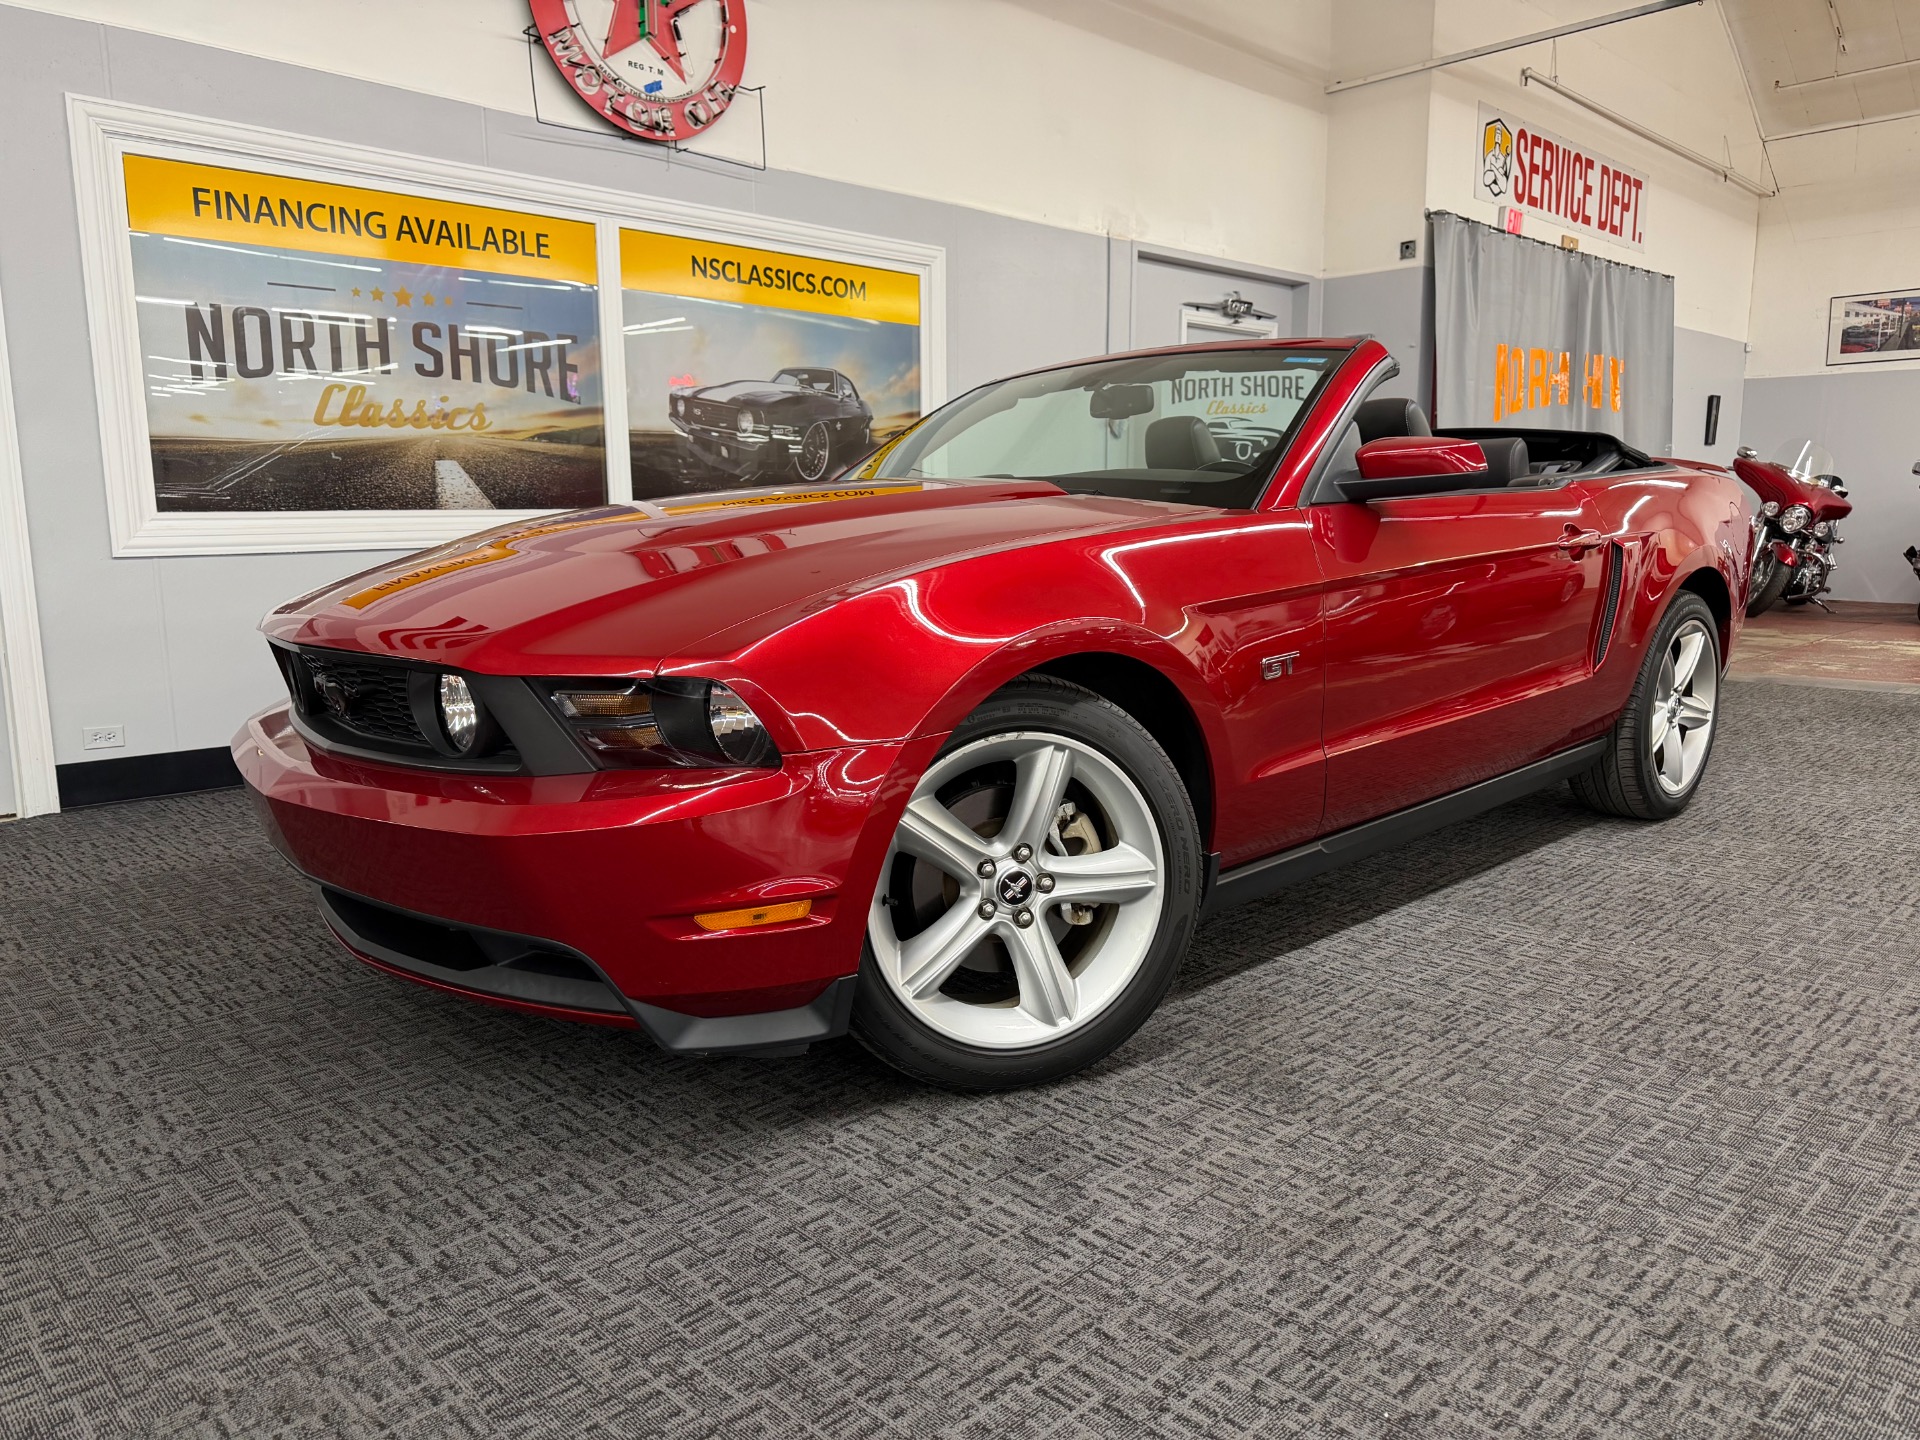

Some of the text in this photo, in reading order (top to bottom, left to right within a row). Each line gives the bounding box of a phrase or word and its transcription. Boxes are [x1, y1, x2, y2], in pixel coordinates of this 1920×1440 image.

[1514, 128, 1643, 244] SERVICE DEPT.
[192, 187, 551, 259] FINANCING AVAILABLE
[691, 255, 867, 301] NSCLASSICS.COM
[185, 301, 581, 405] NORTH SHORE
[313, 383, 493, 431] Classics
[1171, 375, 1305, 404] NORTH SHORE
[1206, 400, 1268, 415] Classics
[1261, 650, 1300, 680] GT
